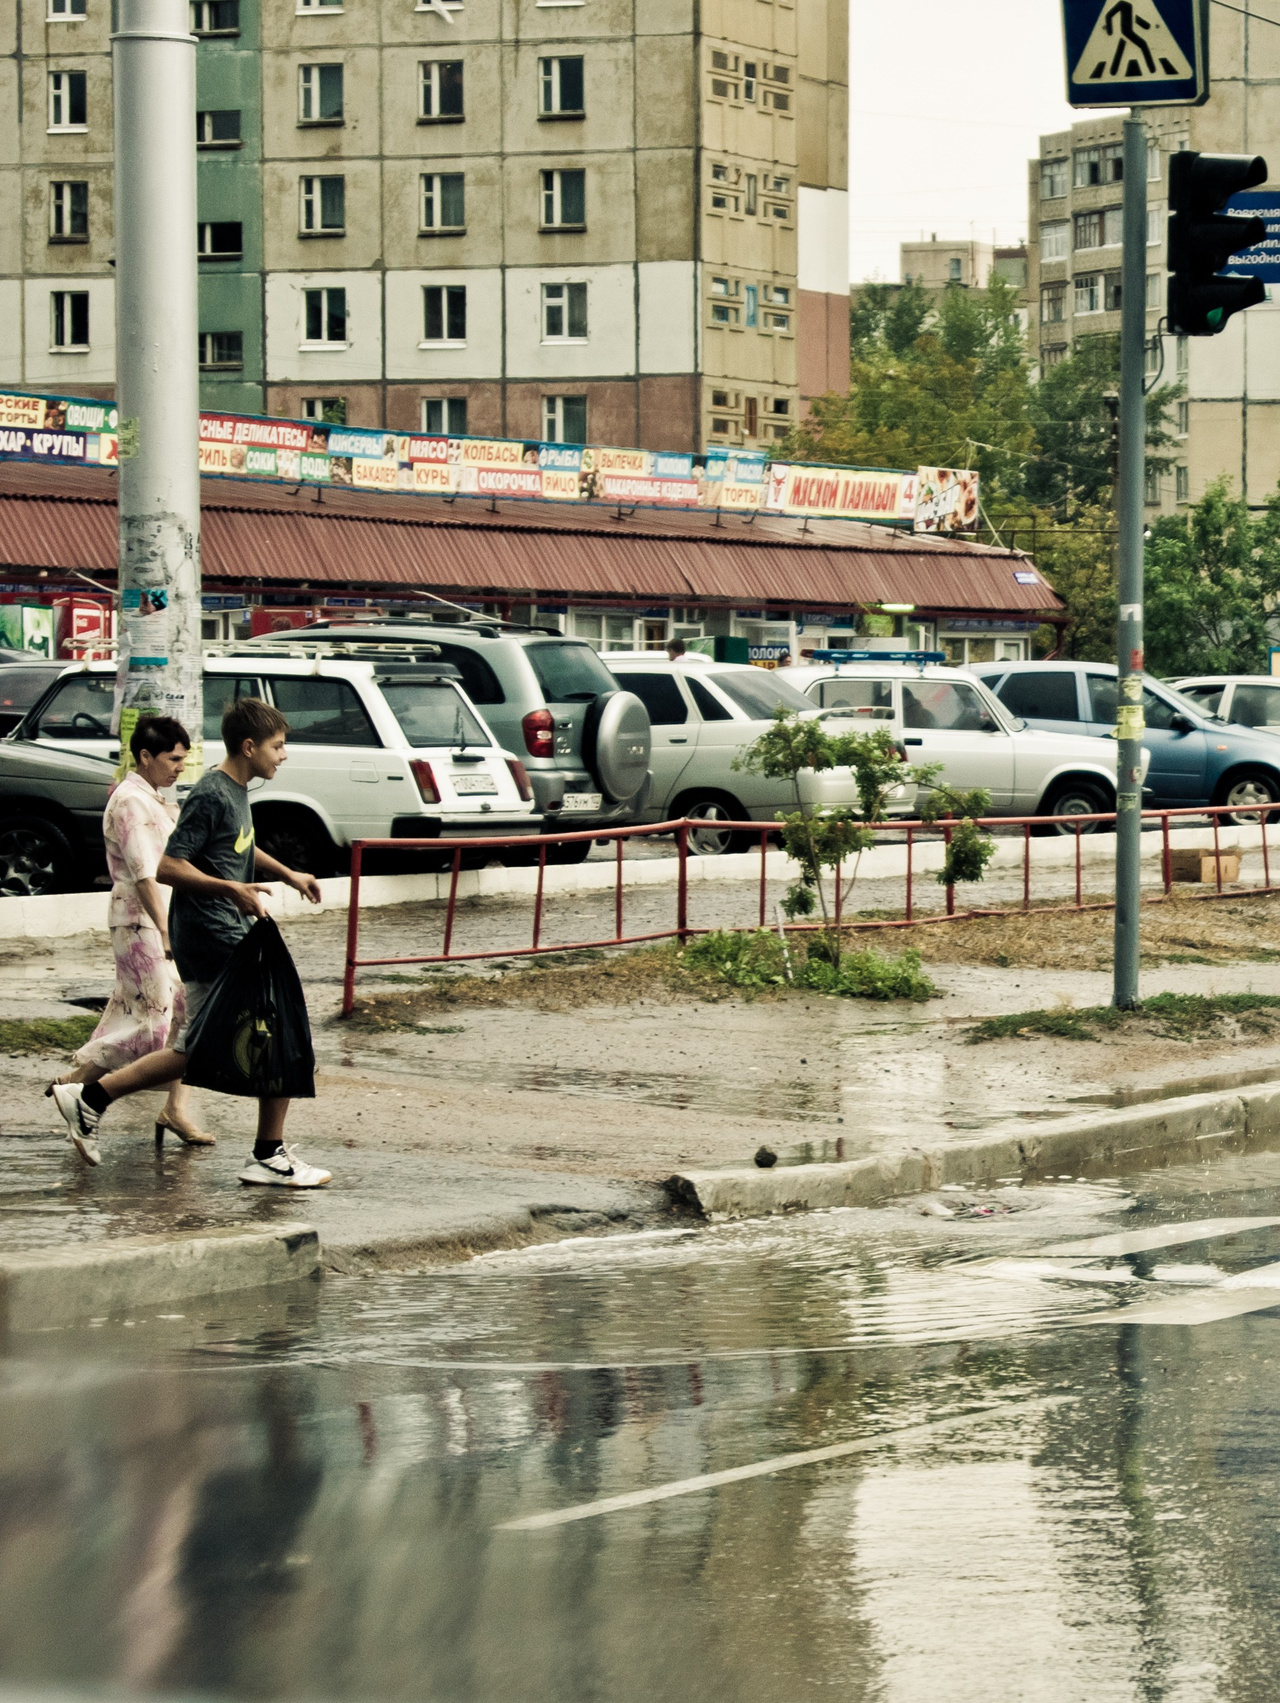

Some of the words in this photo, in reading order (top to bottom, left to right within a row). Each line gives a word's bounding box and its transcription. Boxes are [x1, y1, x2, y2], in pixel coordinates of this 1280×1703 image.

[67, 404, 105, 431] ОВОЩИ
[32, 432, 84, 457] КРУПЫ
[233, 422, 308, 448] ДЕЛИКАТЕСЫ
[199, 447, 228, 467] РИЛЬ
[409, 440, 448, 459] МЯСО
[463, 444, 519, 463] КОЛБАСЫ
[547, 448, 580, 467] РЫБА
[246, 451, 276, 471] СОКИ
[600, 453, 645, 470] ВЫПЕЧКА
[416, 468, 451, 486] КУРЫ
[479, 471, 542, 491] ОКОРОЧКА
[545, 473, 576, 496] ЯЙЦО
[724, 488, 757, 504] ТОРТЫ
[748, 646, 789, 660] ОЛОК
